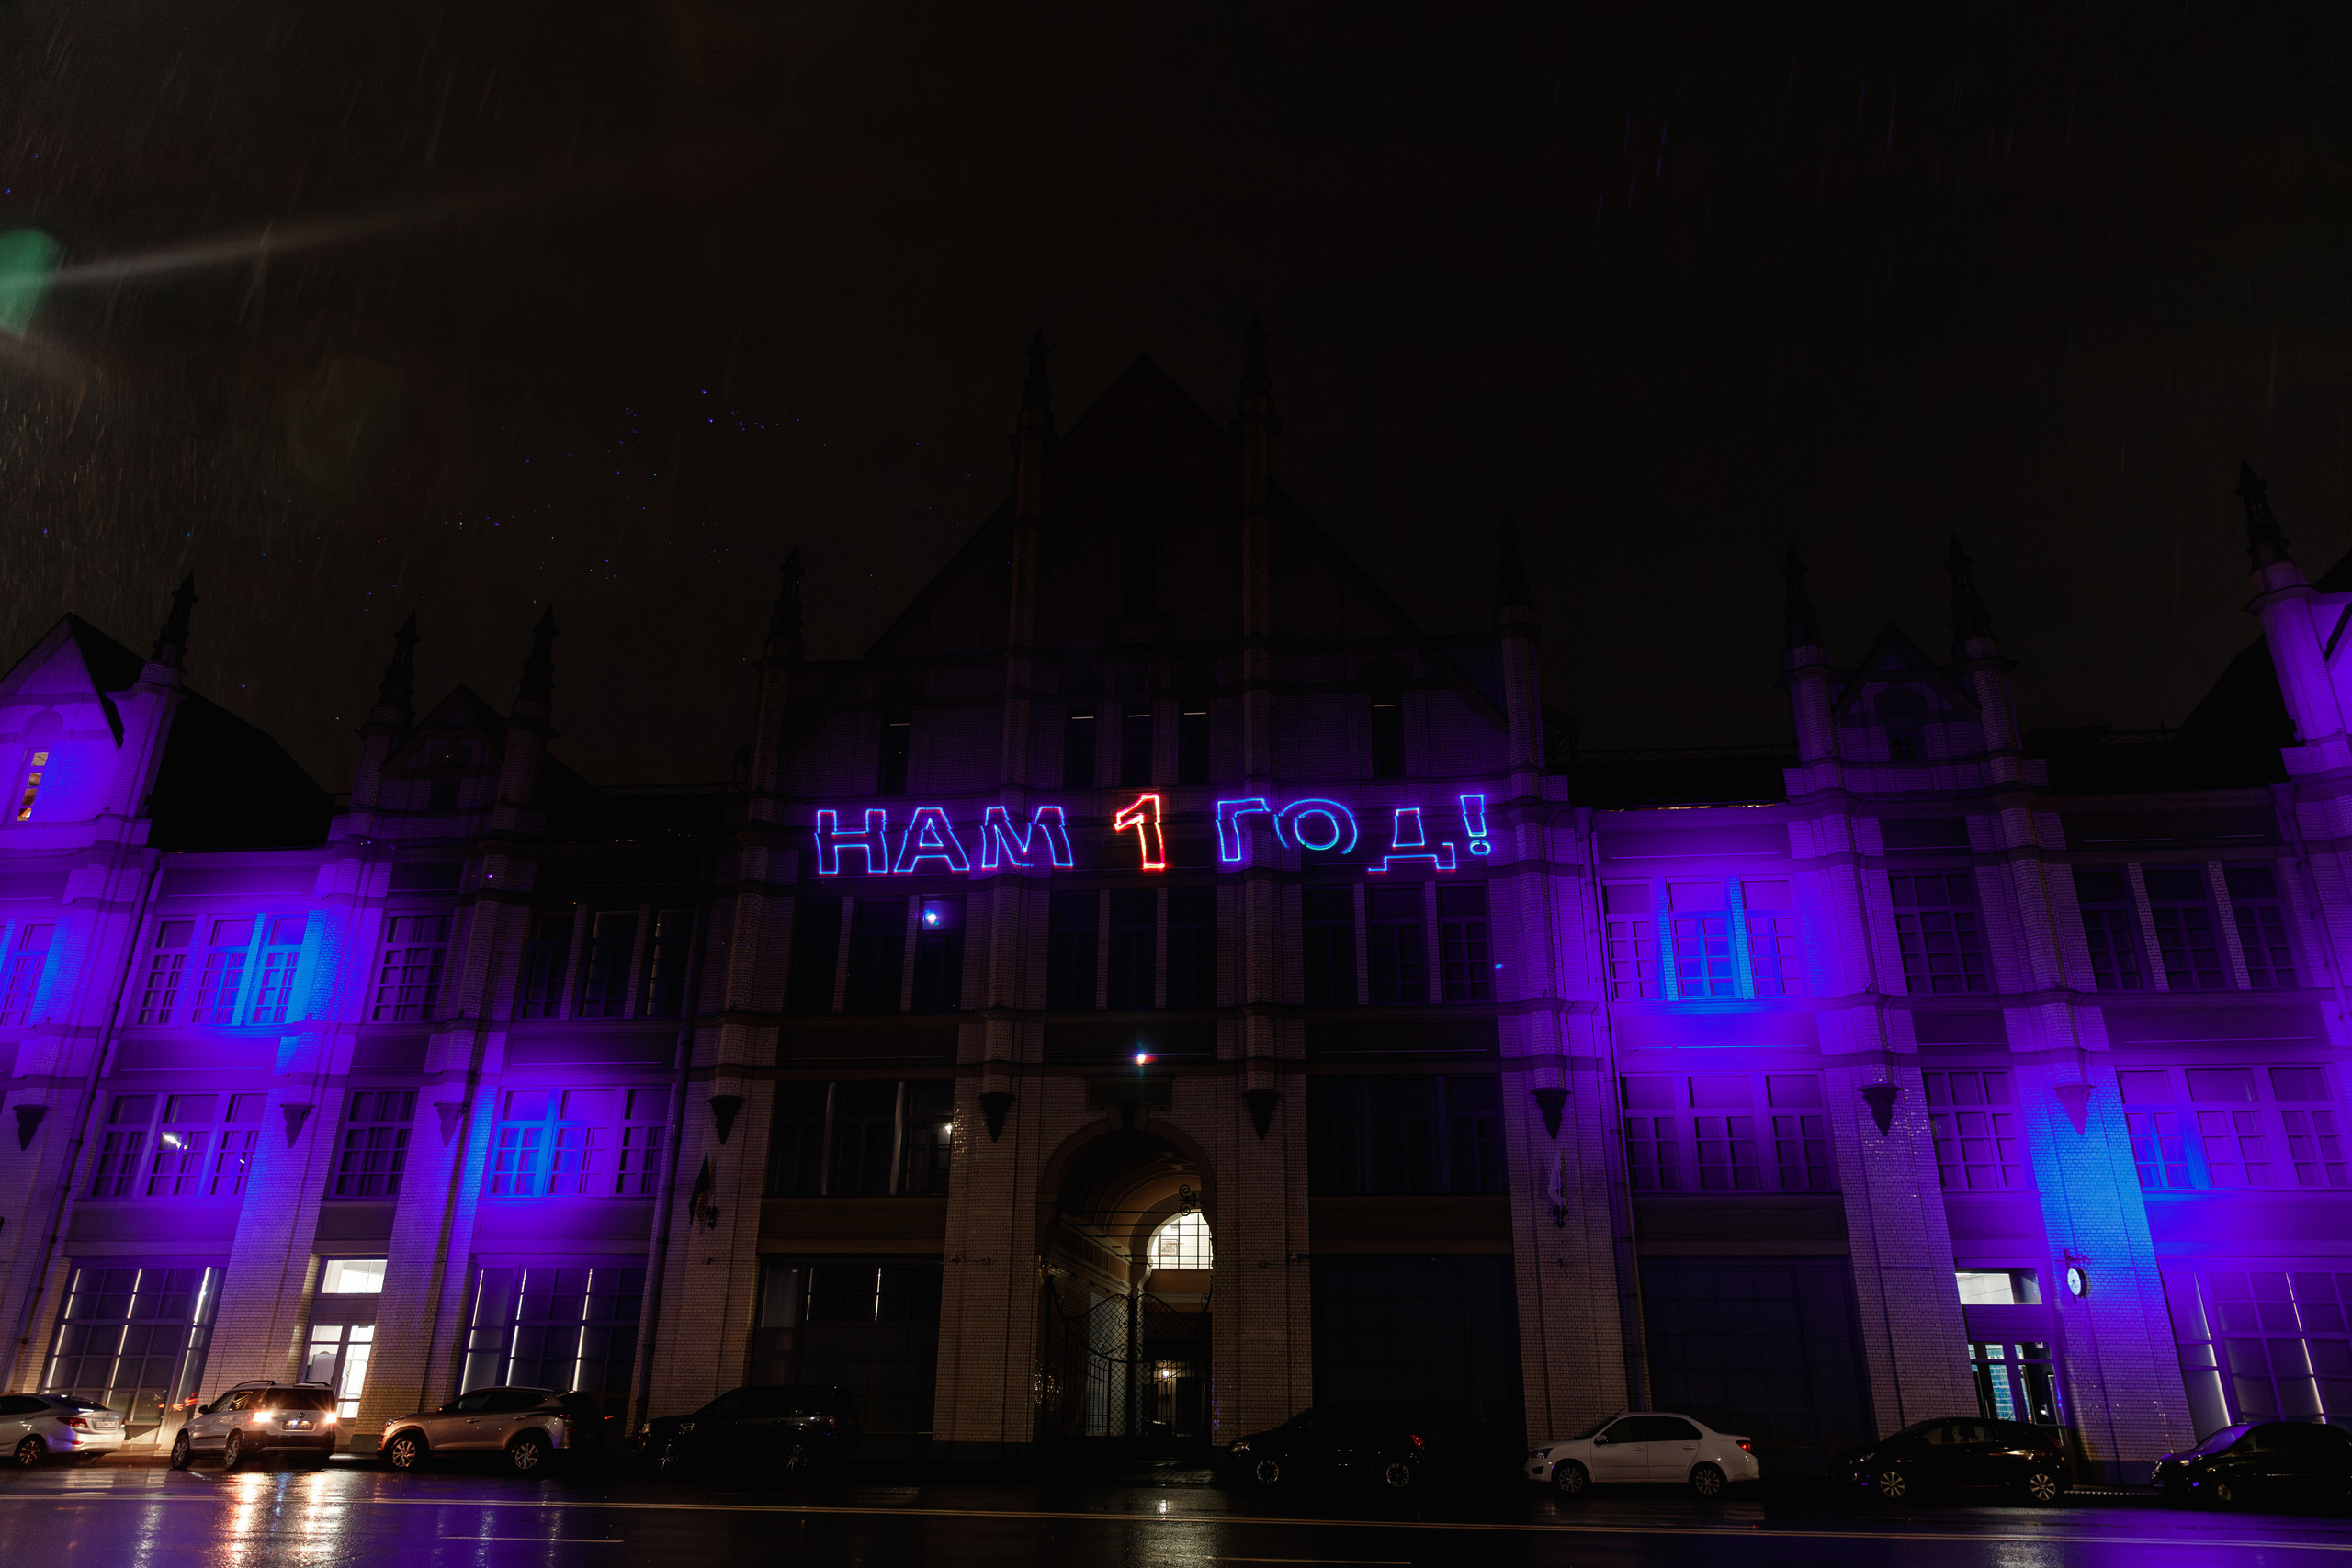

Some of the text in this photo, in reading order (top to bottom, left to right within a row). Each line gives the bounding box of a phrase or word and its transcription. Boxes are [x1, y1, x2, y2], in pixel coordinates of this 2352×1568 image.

[814, 793, 1491, 876] НАМ 1 ГОД!
